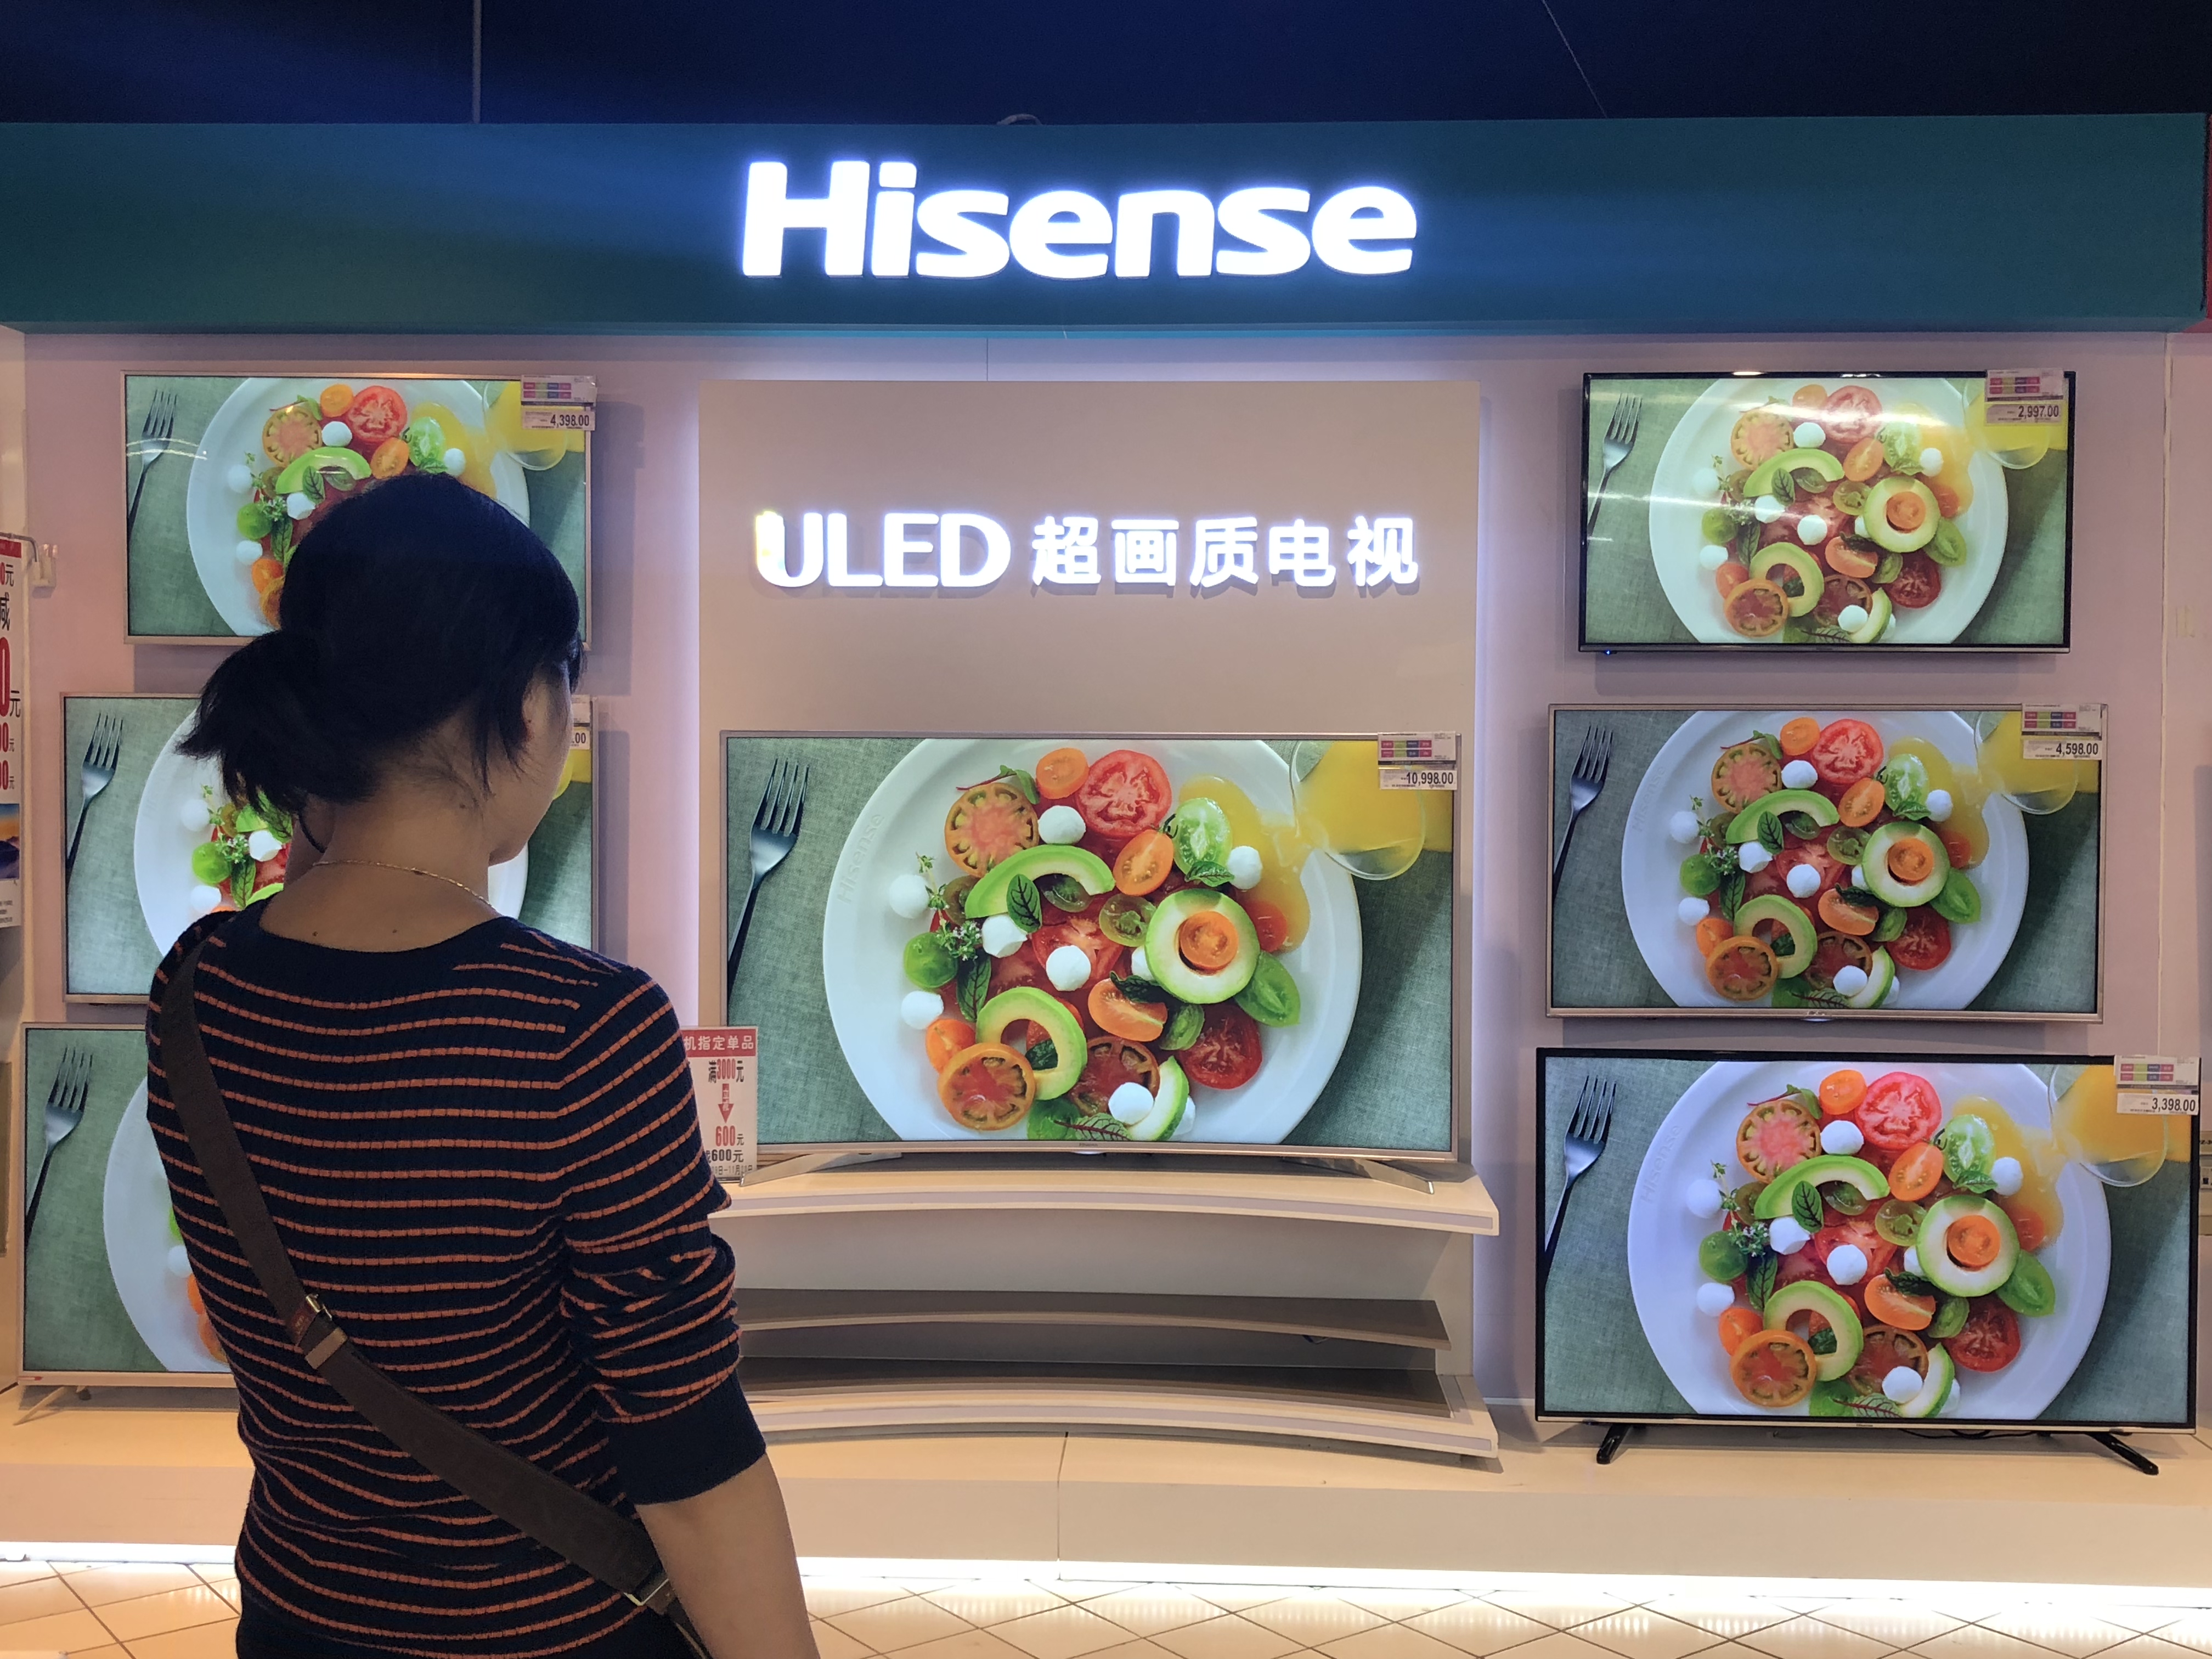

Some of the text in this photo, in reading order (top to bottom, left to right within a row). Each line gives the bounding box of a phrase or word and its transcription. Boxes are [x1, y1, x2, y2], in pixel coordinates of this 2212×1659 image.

[742, 160, 1418, 279] Hisense
[2018, 405, 2059, 419] 2,997.00
[550, 414, 590, 428] 4,398.00
[755, 510, 1419, 588] ULED 超画质电视
[2056, 742, 2098, 757] 4,598.00
[1406, 772, 1454, 786] 10,998.00
[837, 814, 884, 904] Hisense
[2152, 1097, 2196, 1111] 3,398.00
[715, 1125, 744, 1147] 600元
